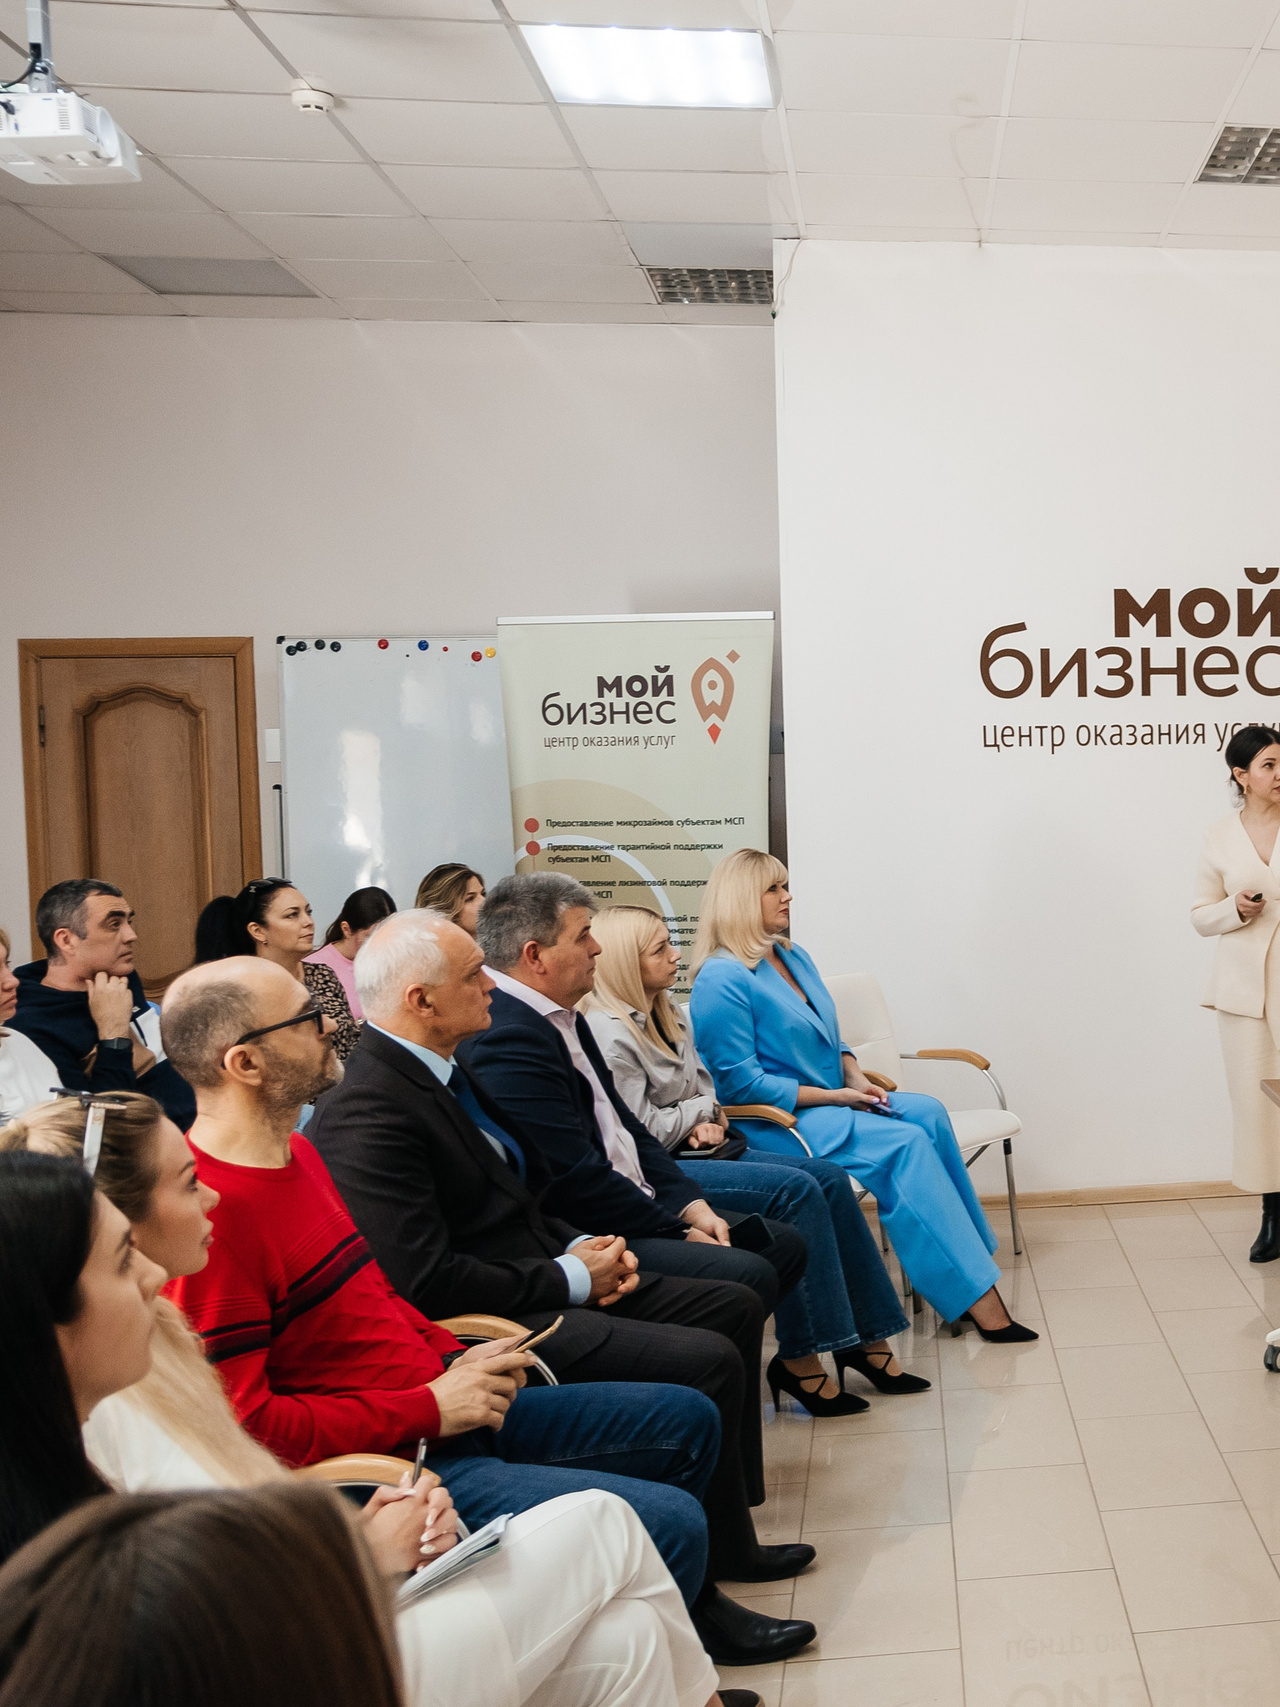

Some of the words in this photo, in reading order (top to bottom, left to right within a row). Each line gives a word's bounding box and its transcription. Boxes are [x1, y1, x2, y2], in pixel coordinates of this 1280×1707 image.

[596, 665, 675, 699] мой
[541, 691, 677, 726] бизнес
[543, 736, 579, 750] центр
[582, 735, 640, 747] оказания
[642, 735, 677, 750] услуг
[982, 723, 1066, 754] центр
[1075, 723, 1206, 746] оказания
[545, 818, 614, 828] Предоставление
[616, 818, 674, 828] микрозаймов
[676, 817, 722, 828] субъектам
[724, 817, 745, 825] МСП
[547, 842, 615, 852] Предоставление
[617, 842, 671, 852] гарантийной
[673, 842, 724, 852] поддержки
[547, 855, 590, 864] субъектам
[591, 854, 611, 863] МСП
[618, 878, 668, 888] лизинговой
